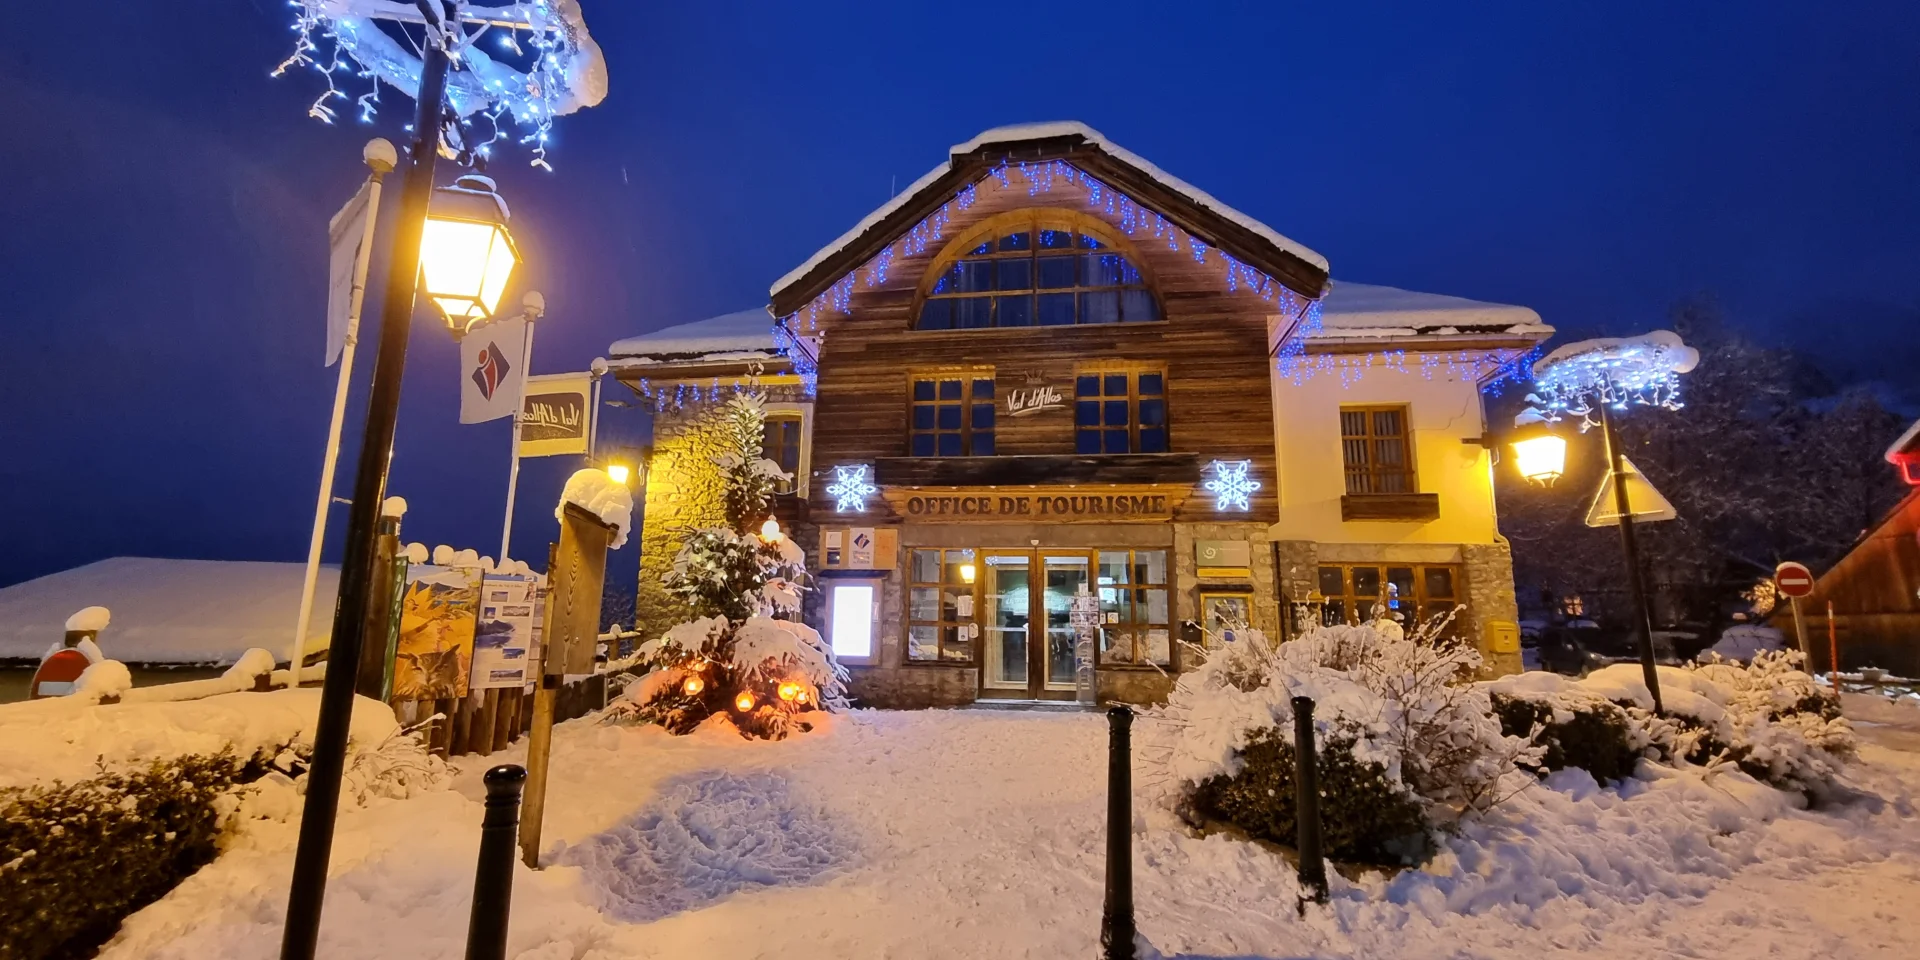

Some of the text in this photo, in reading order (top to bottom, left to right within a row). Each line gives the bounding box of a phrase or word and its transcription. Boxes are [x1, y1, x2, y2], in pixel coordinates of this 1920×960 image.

[1007, 385, 1062, 411] Val d'Allos
[907, 494, 1166, 516] OFFICE DE TOURISME
